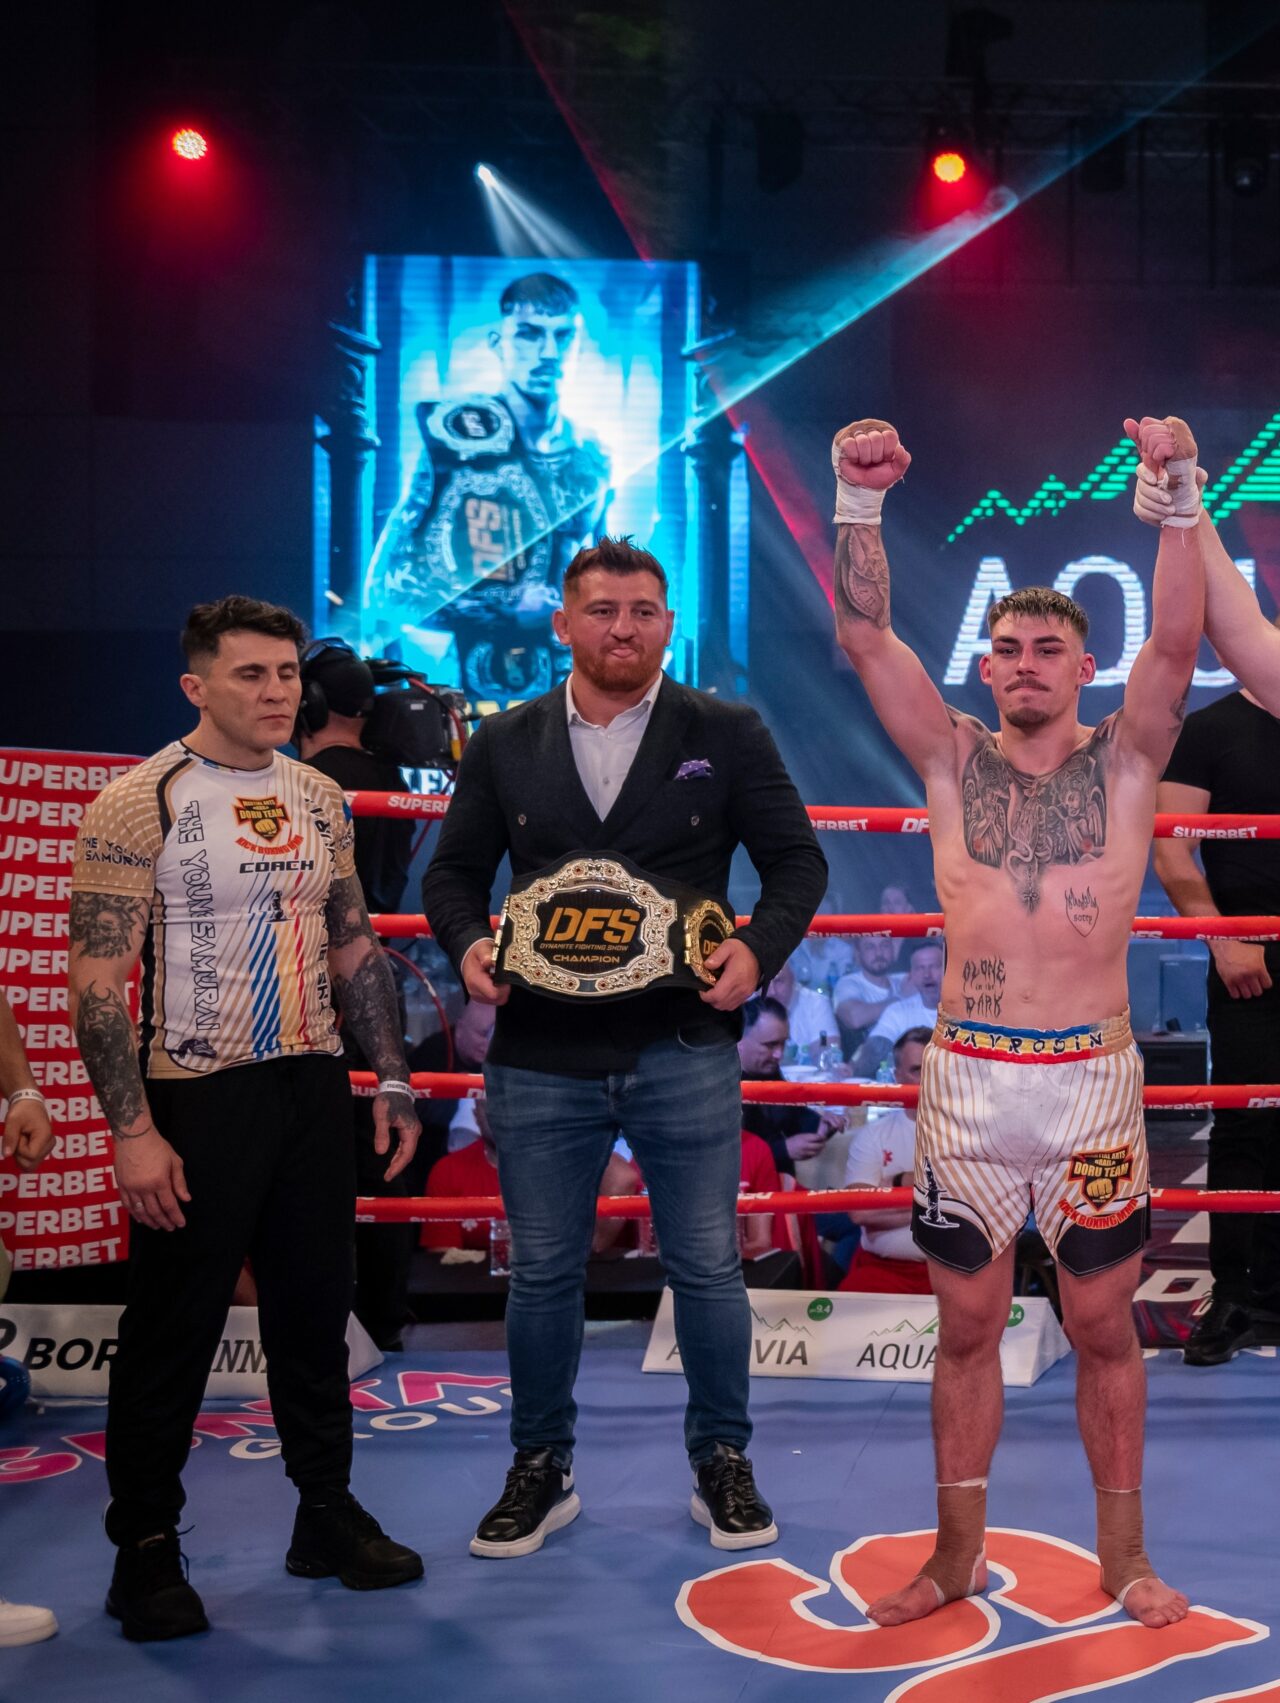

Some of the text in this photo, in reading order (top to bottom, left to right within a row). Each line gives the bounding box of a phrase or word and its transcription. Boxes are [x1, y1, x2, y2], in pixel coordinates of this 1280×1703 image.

[239, 809, 263, 819] DORU
[263, 807, 285, 818] TEAM
[178, 800, 204, 844] THE
[1172, 825, 1258, 839] SUPERBET
[239, 860, 315, 874] COACH
[544, 907, 641, 944] DFS
[575, 943, 607, 951] FIGHTING
[553, 954, 620, 964] CHAMPION
[190, 922, 220, 1031] SAMURAI
[1073, 1162, 1129, 1178] DORU TEAM
[1076, 1214, 1117, 1230] BOXING
